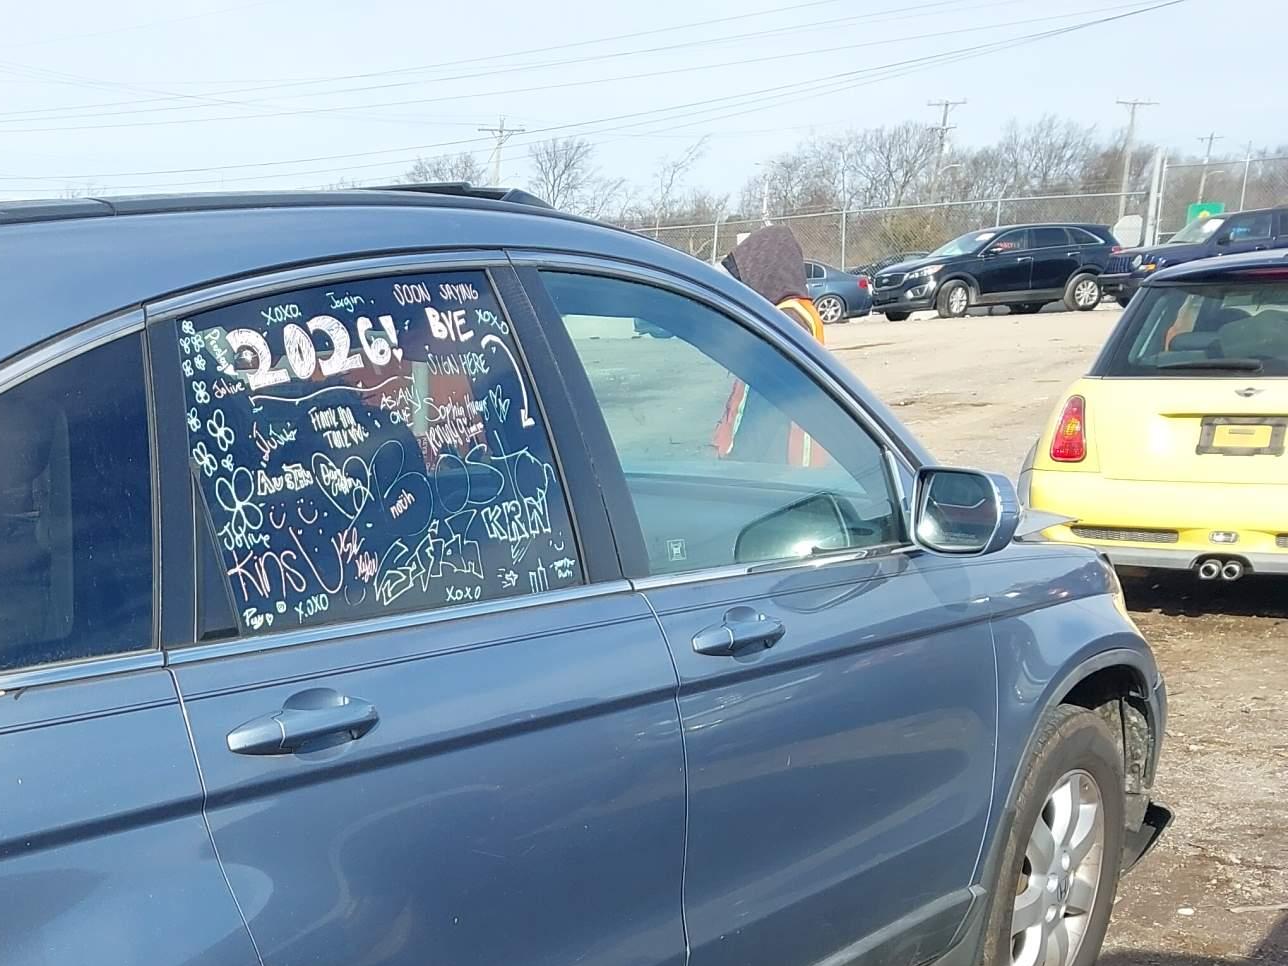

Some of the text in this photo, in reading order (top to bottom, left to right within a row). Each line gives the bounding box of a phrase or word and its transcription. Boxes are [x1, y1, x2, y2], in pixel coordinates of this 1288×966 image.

[393, 281, 479, 306] SOON SAYING
[424, 306, 475, 342] BYE
[225, 314, 404, 392] 2026!
[458, 351, 491, 376] HERE
